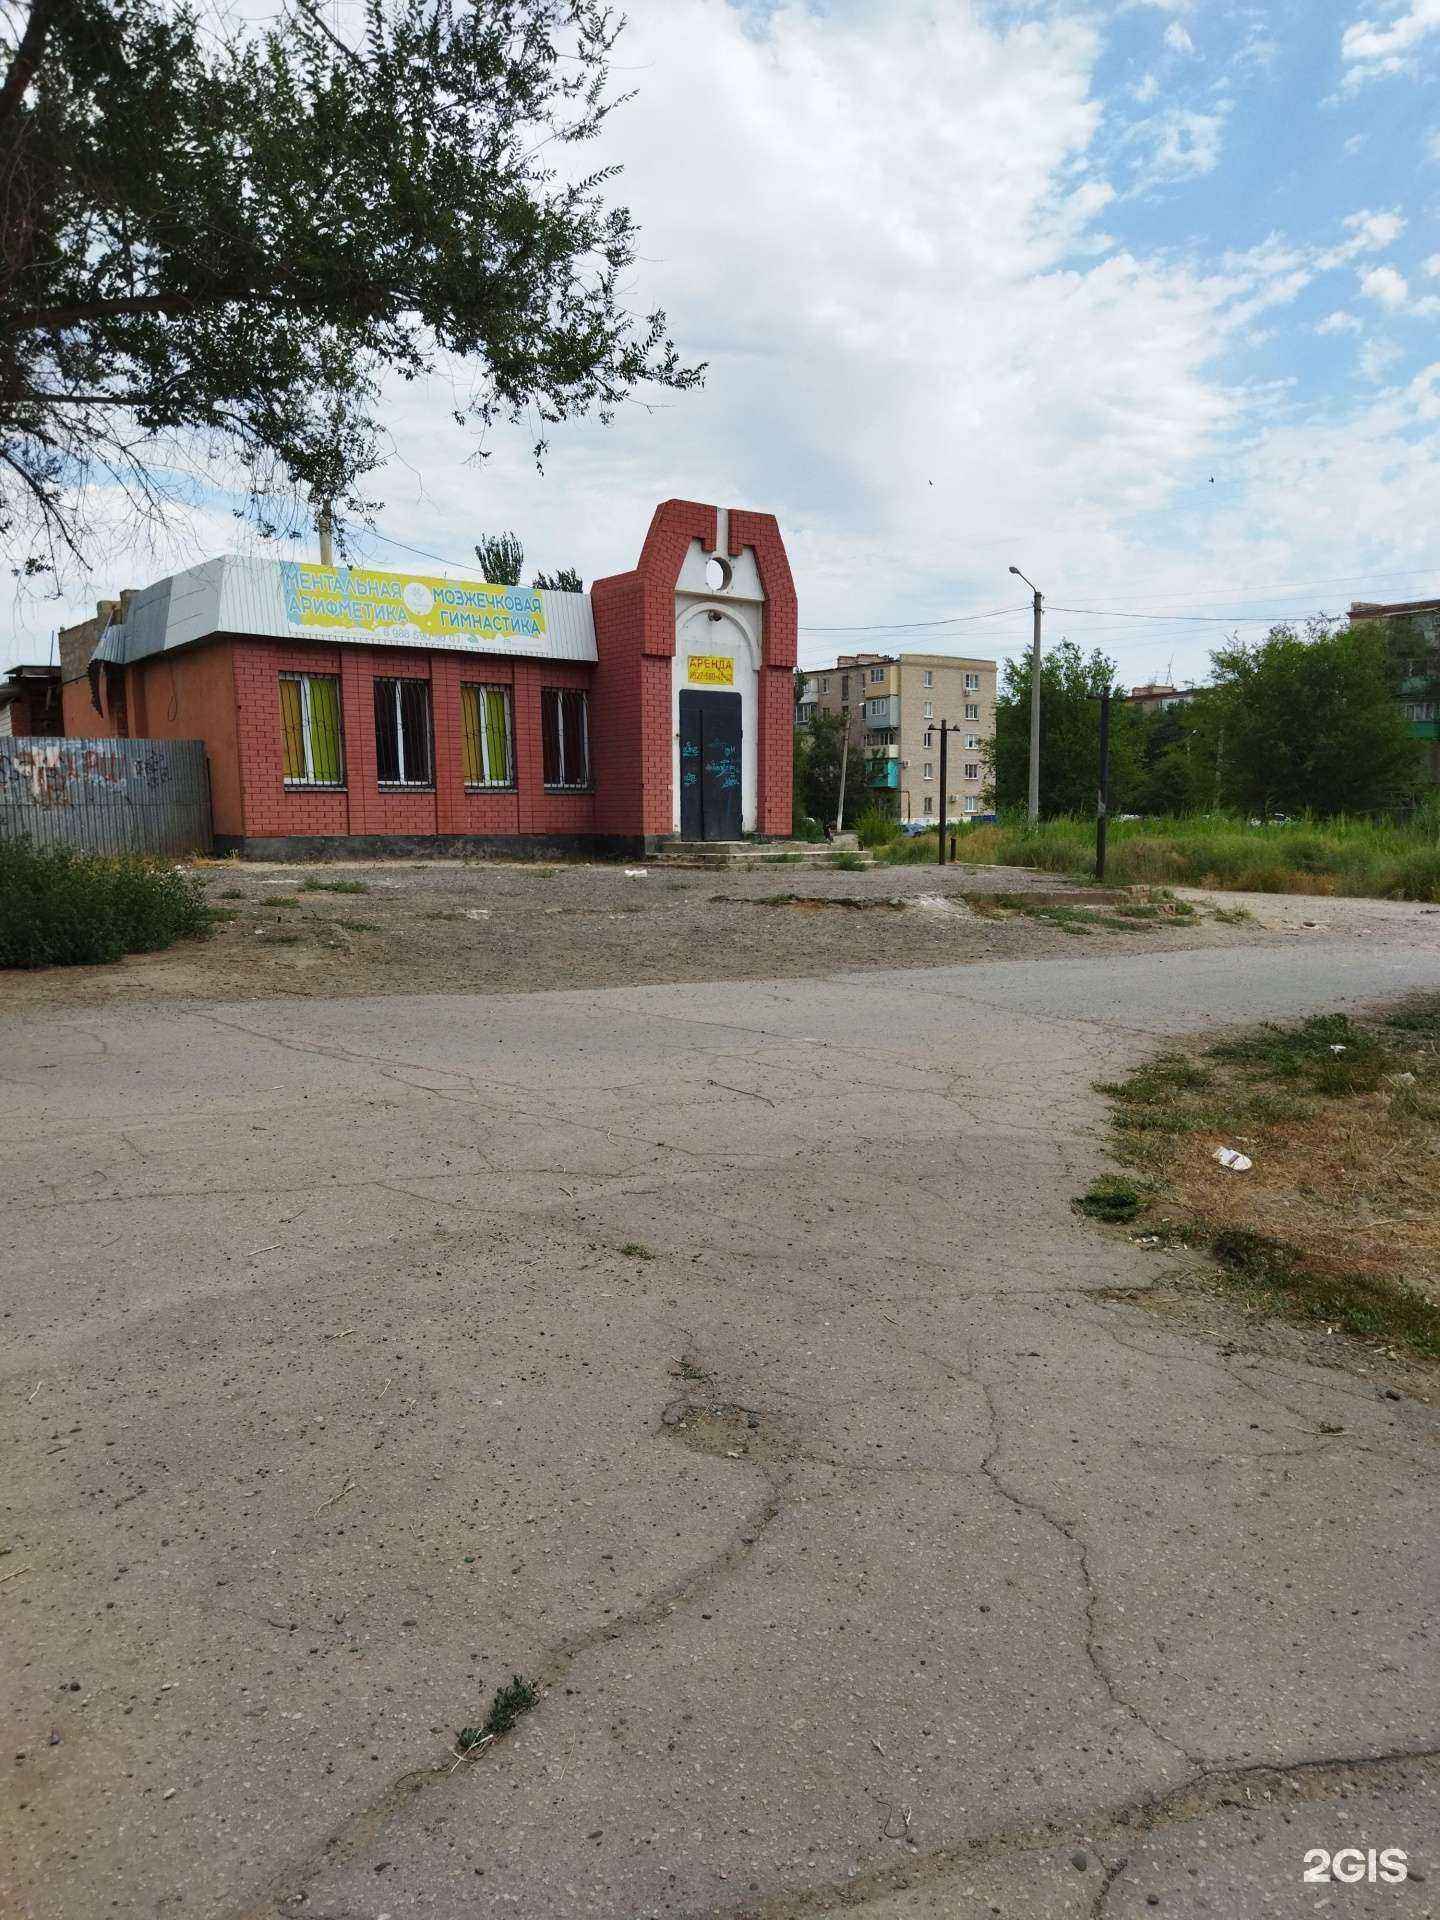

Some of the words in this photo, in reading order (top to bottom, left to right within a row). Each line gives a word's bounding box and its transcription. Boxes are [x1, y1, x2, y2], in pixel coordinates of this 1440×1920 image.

[285, 570, 403, 599] МЕНТАЛЬНАЯ
[287, 594, 409, 623] АРИФМЕТИКА
[432, 588, 542, 613] МОЗЖЕЧКОВАЯ
[440, 610, 541, 635] ГИМНАСТИКА
[690, 658, 732, 670] АРЕНДА
